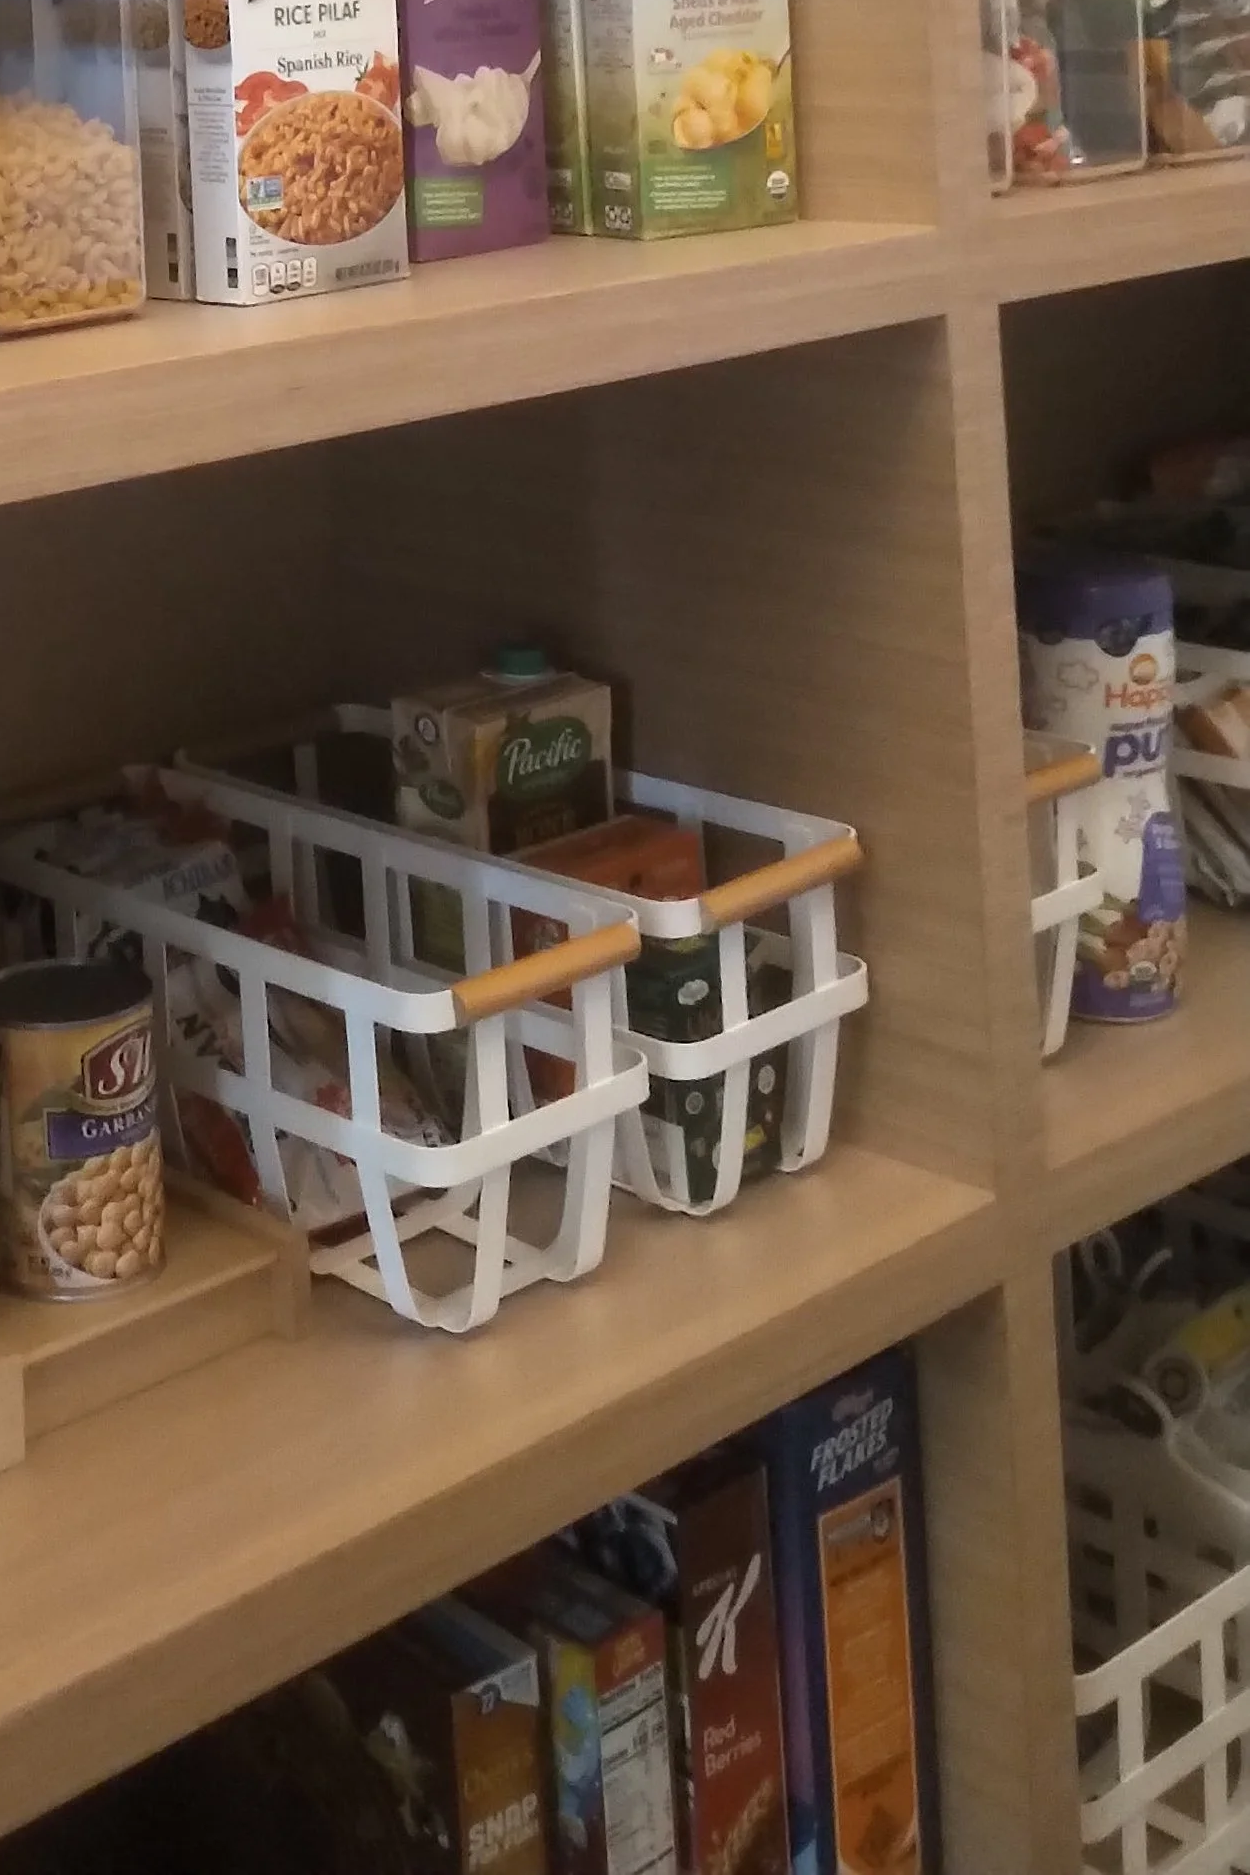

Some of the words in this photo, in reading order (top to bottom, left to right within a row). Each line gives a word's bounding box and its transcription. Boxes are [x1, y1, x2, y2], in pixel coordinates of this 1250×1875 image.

[274, 5, 312, 27] RICE
[318, 0, 361, 23] PILAF
[276, 52, 333, 77] Spanish
[336, 50, 364, 67] Rice
[503, 727, 582, 785] Pacific
[810, 1396, 894, 1473] FROSTED
[816, 1433, 888, 1492] FLAKES
[703, 1714, 737, 1753] Red
[704, 1729, 763, 1780] Berries
